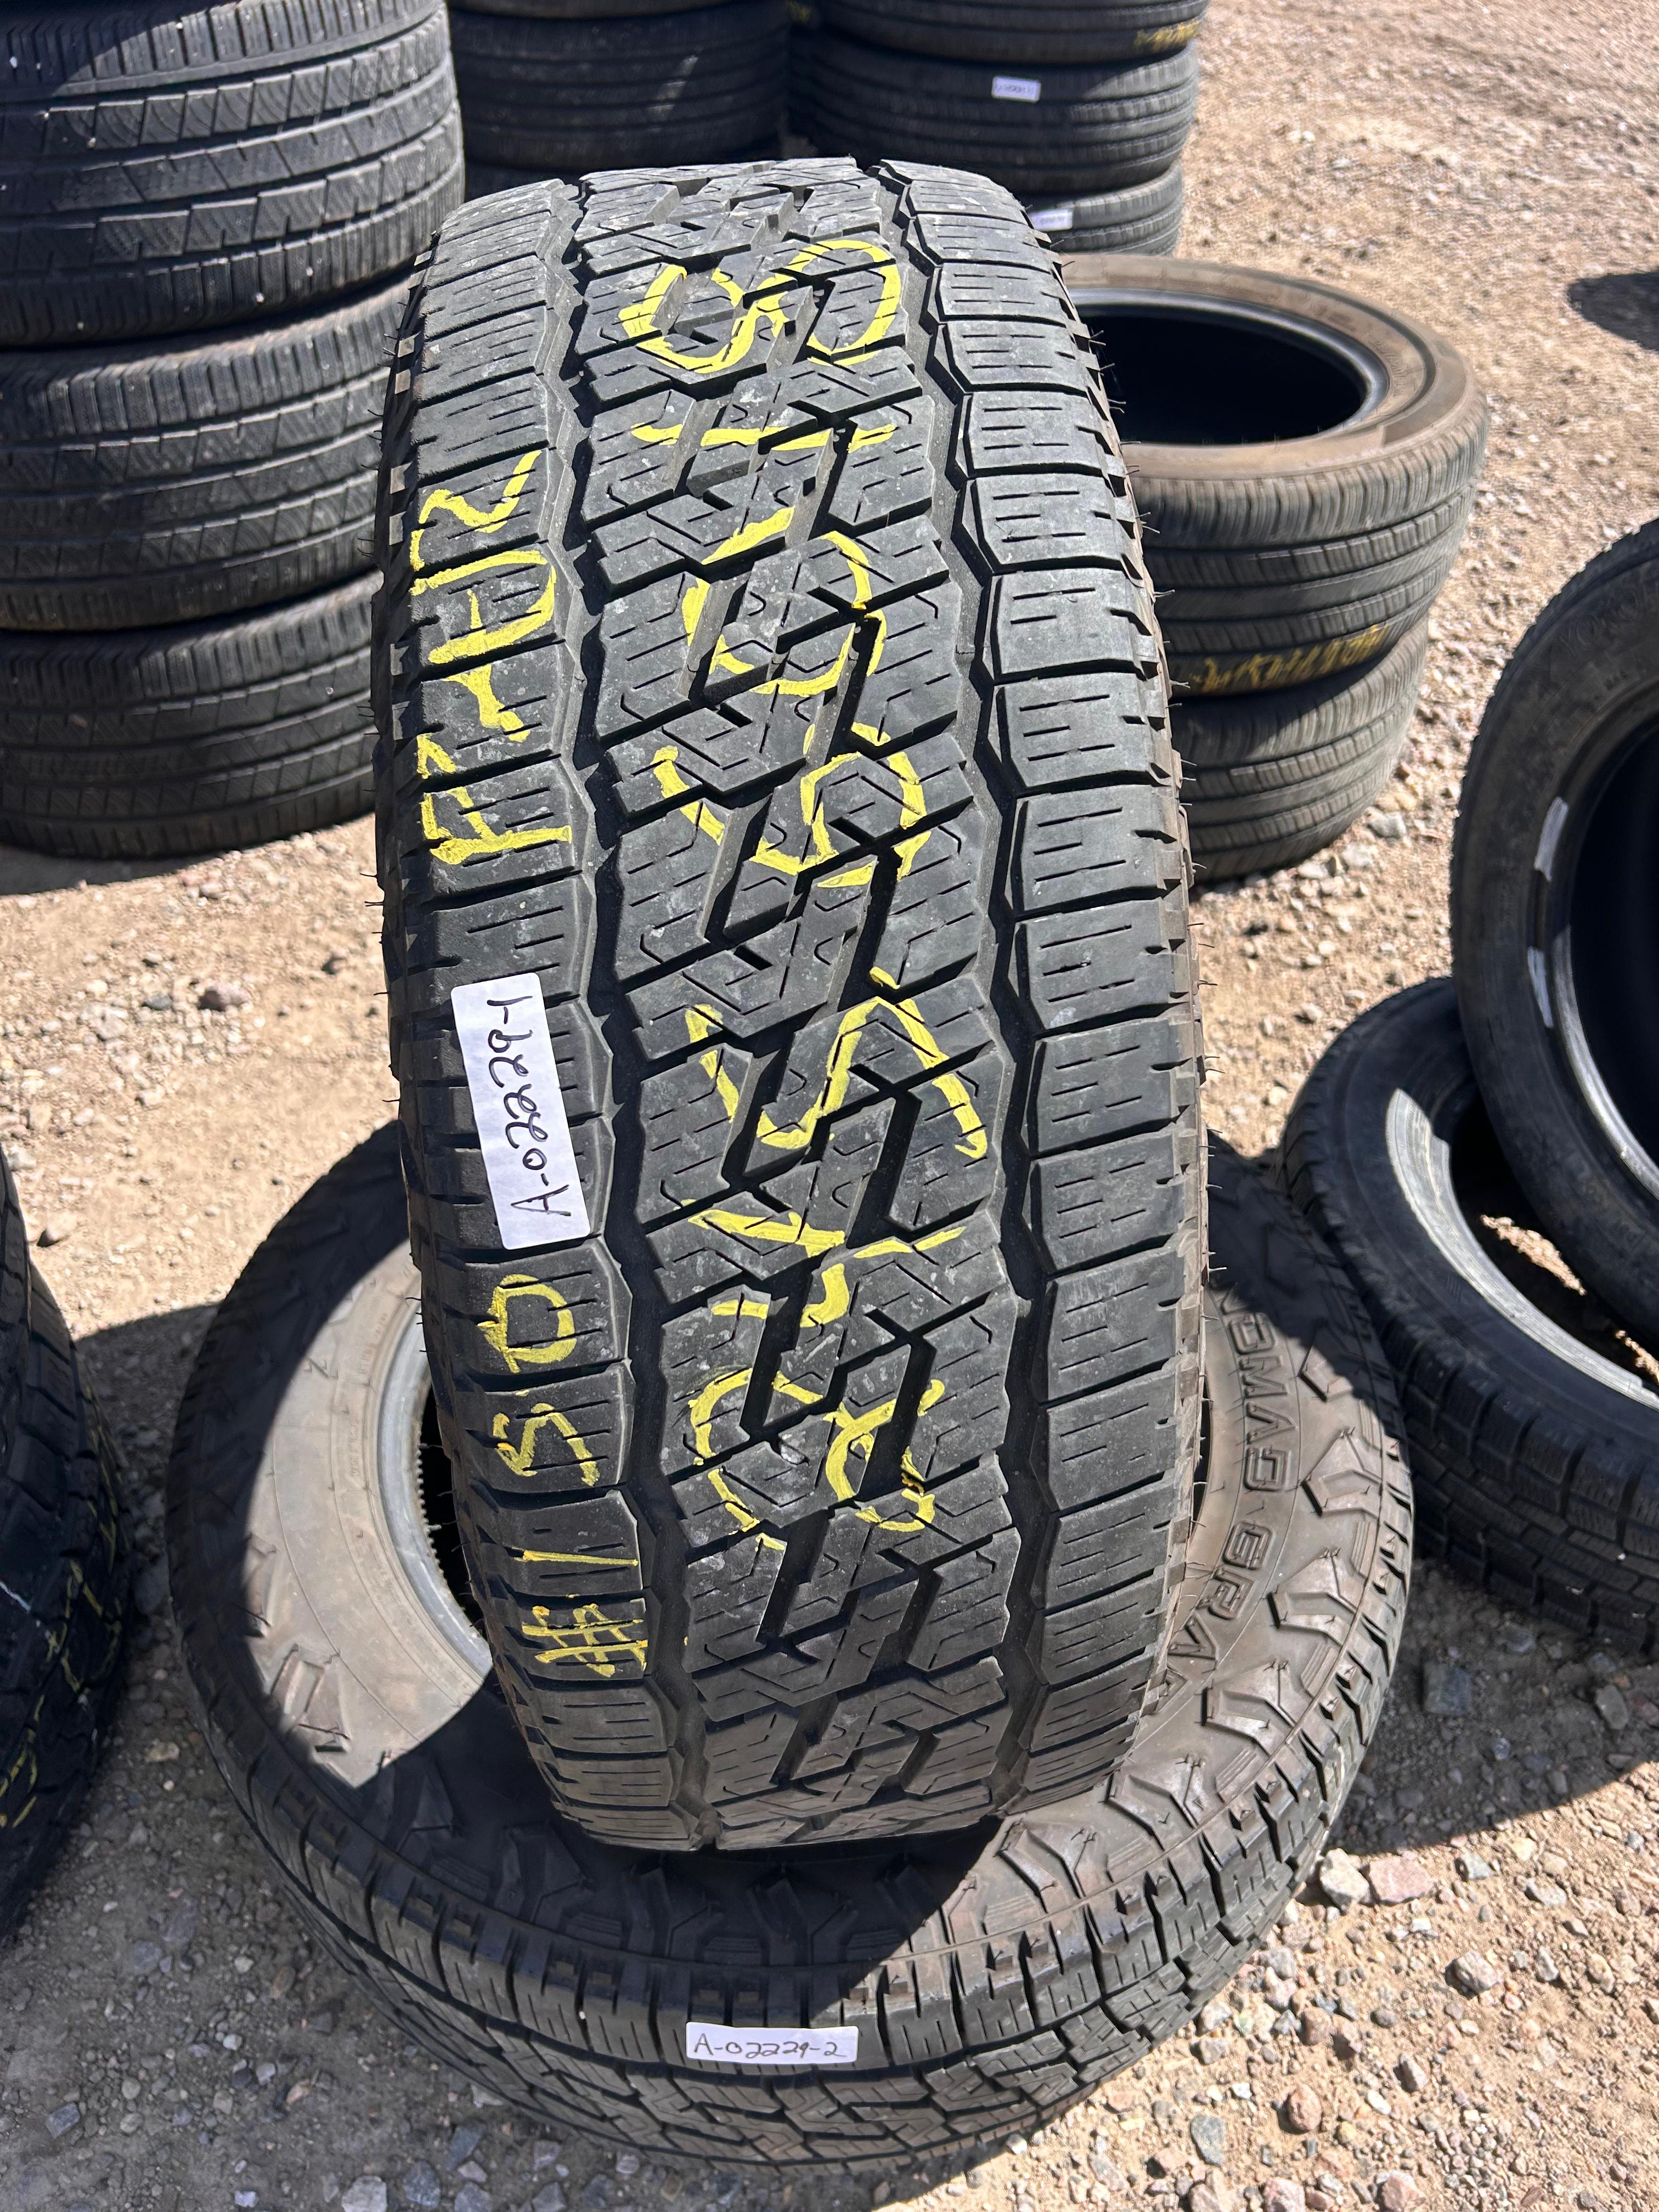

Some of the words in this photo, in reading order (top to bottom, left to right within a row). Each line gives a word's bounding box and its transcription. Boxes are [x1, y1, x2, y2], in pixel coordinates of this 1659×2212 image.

[486, 995, 573, 1217] A-02229-1
[1211, 1279, 1297, 1492] NOMAD
[693, 2032, 848, 2059] A-02229-2
